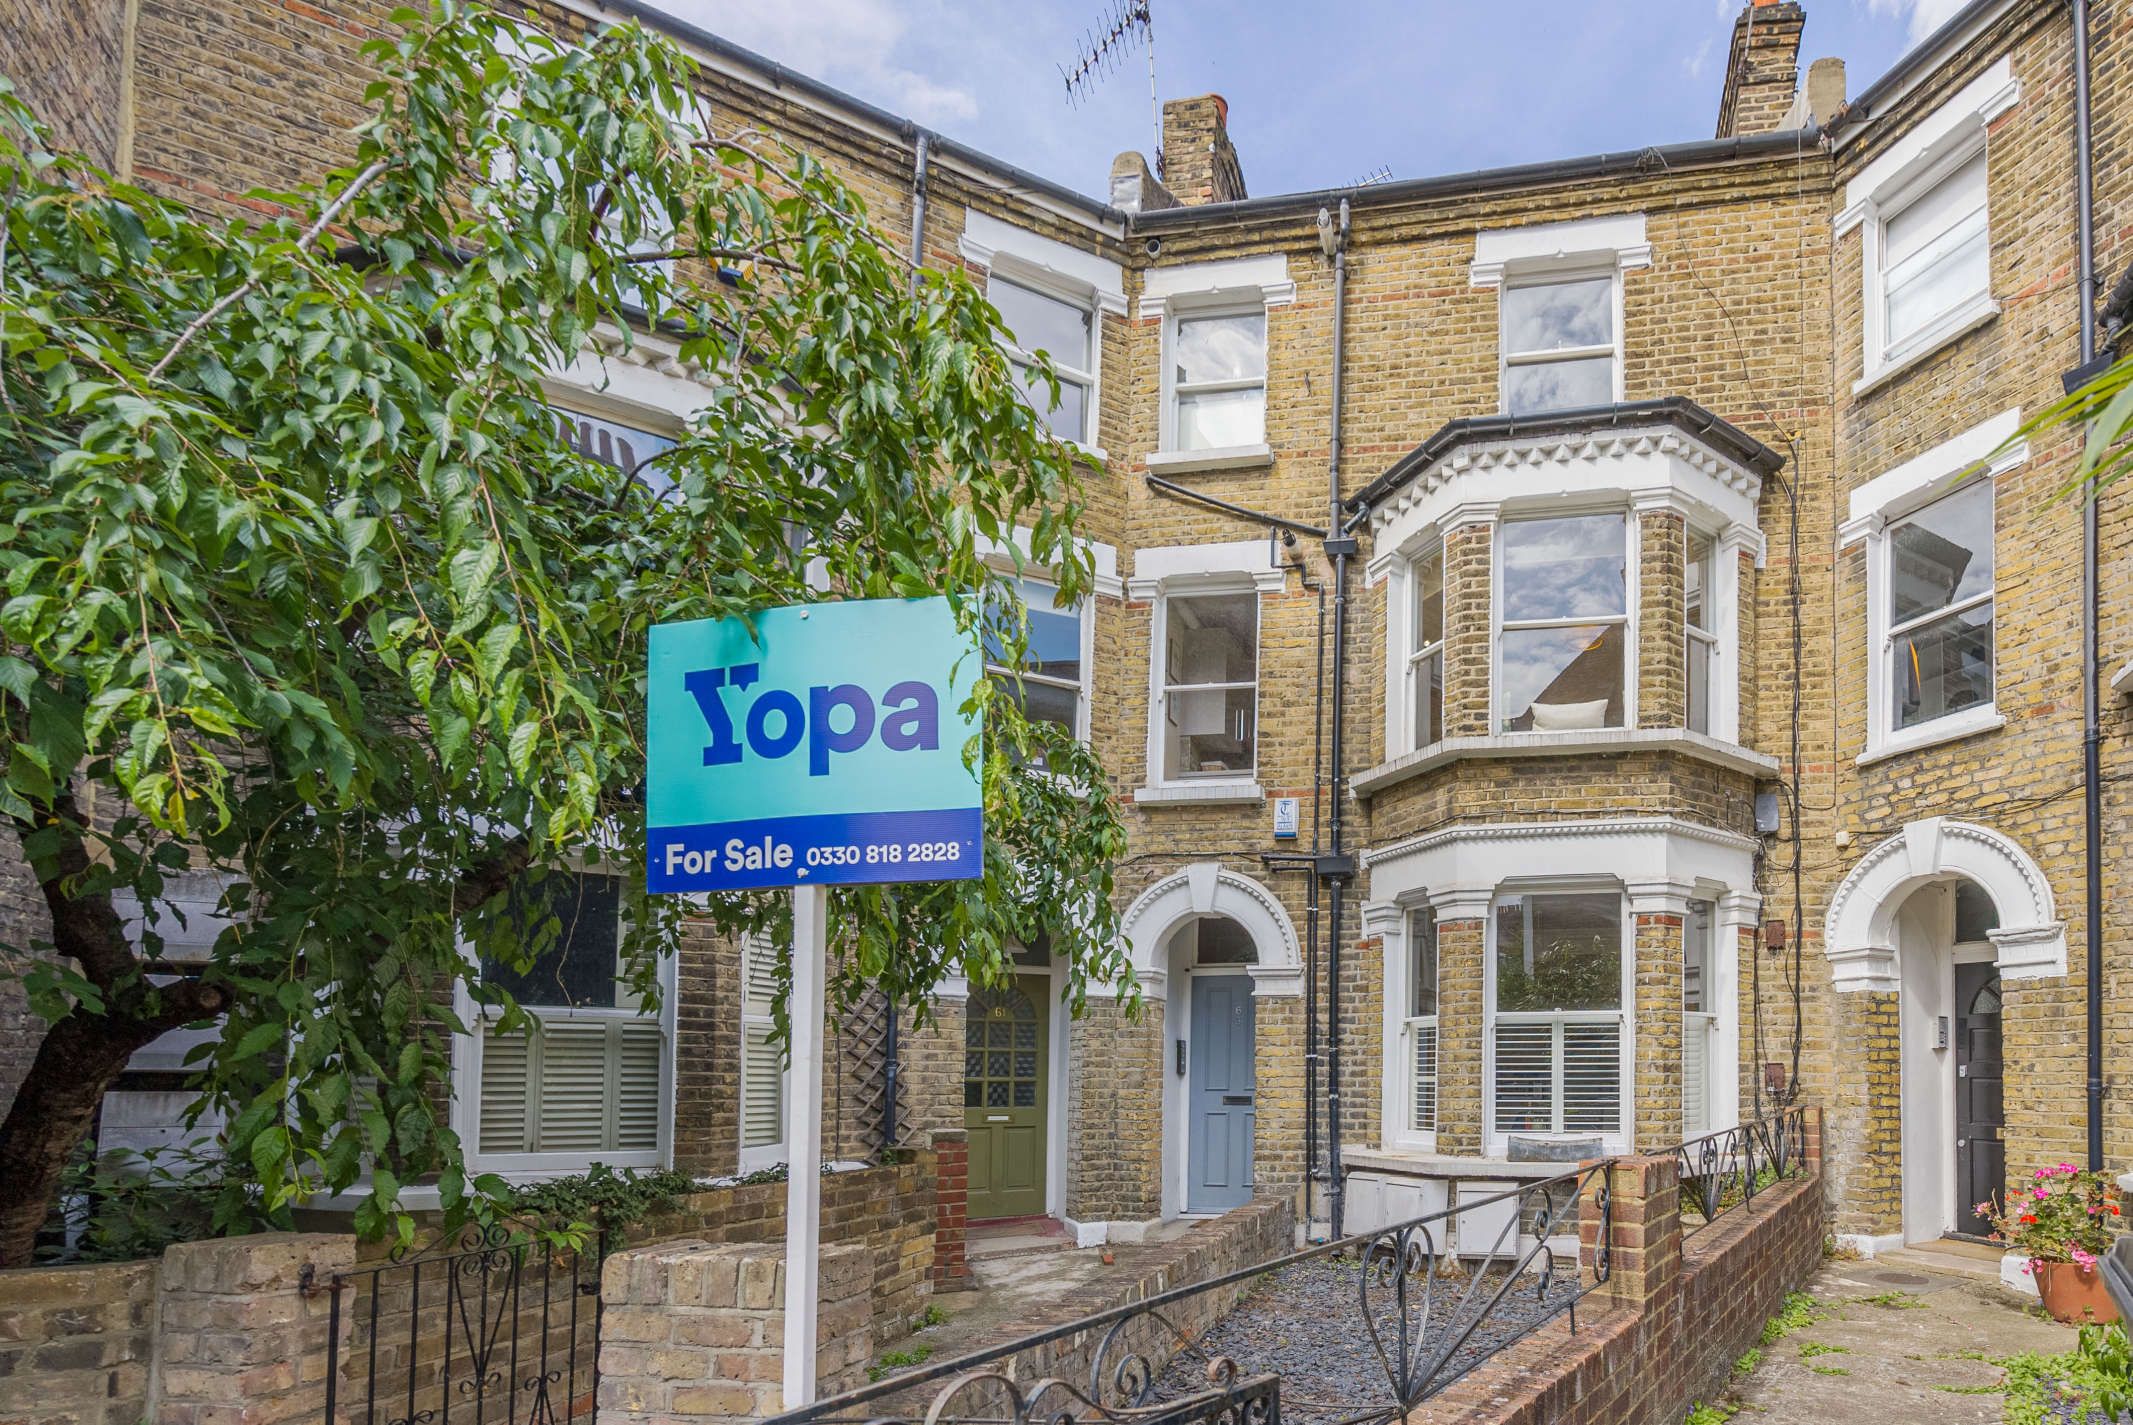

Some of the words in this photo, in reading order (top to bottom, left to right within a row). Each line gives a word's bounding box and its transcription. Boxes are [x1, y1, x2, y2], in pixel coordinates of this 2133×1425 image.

[684, 663, 939, 776] Yopa
[666, 843, 717, 876] For
[724, 836, 794, 872] Sale
[806, 846, 861, 866] 0330
[866, 844, 902, 864] 818
[907, 841, 961, 862] 2828
